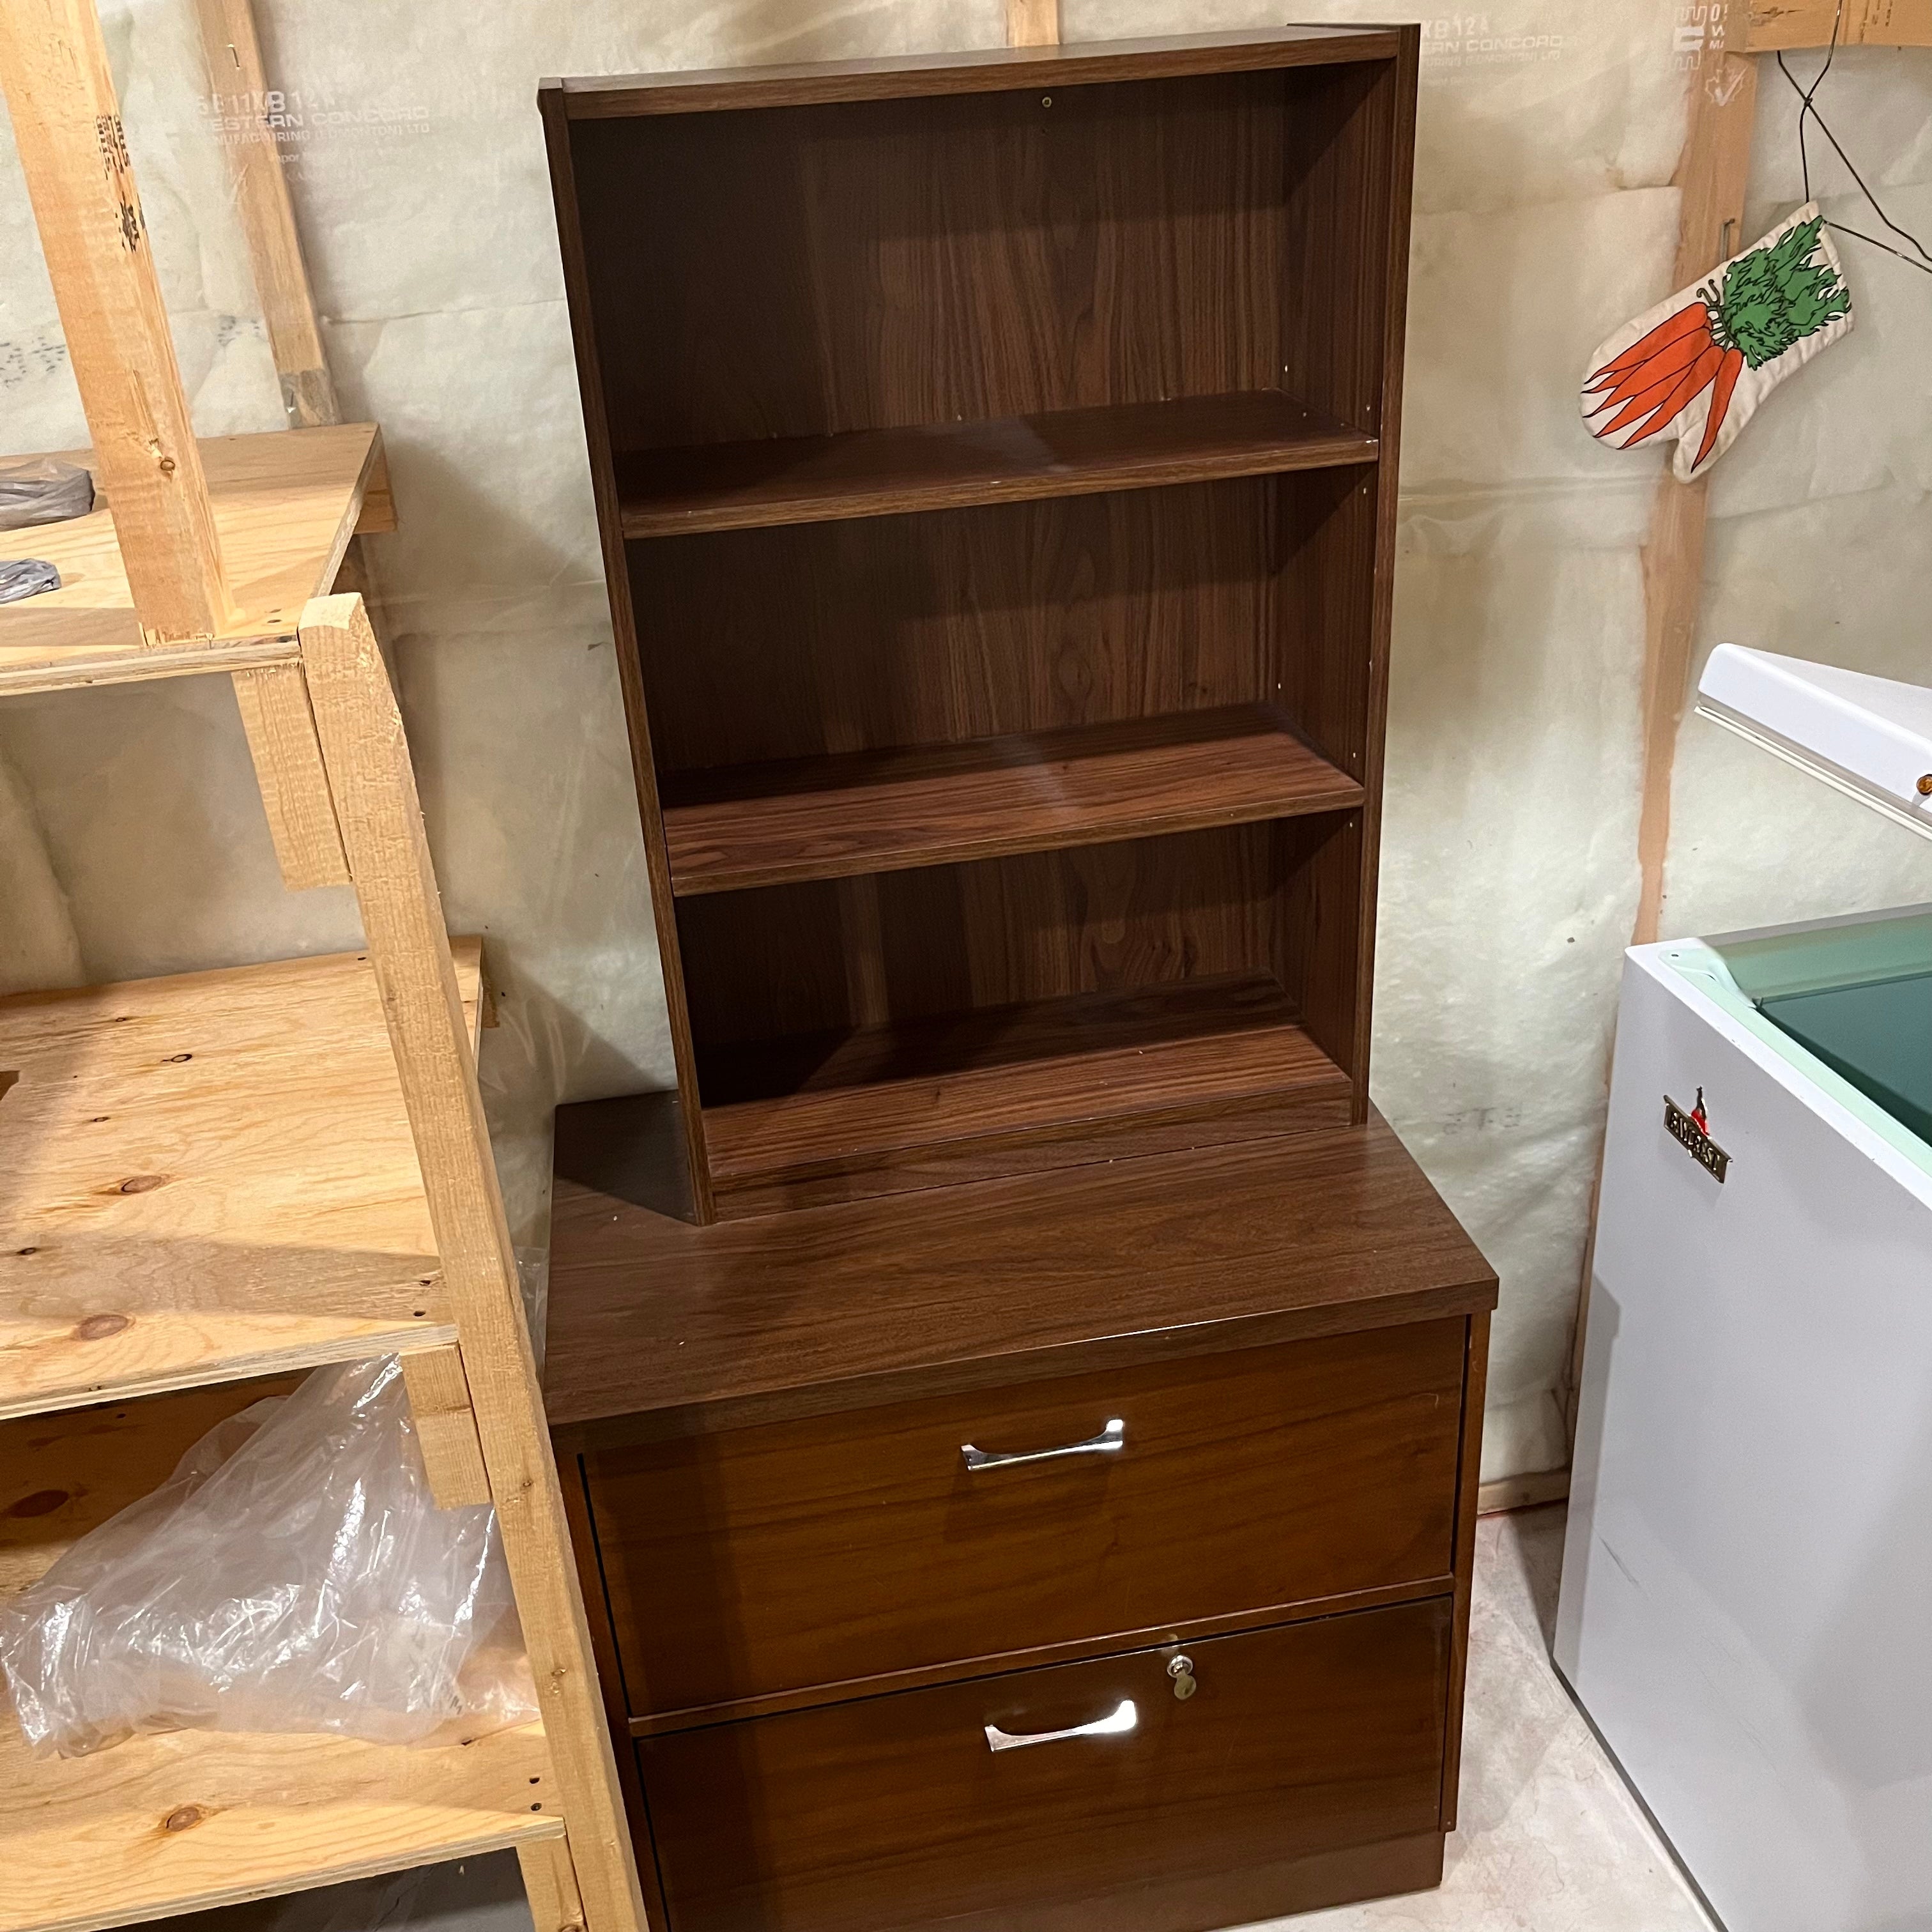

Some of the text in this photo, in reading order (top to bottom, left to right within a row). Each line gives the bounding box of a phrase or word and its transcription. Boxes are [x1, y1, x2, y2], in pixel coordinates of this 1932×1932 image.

[1465, 35, 1563, 52] CONCORD
[211, 106, 429, 132] ESTERN CONCORD
